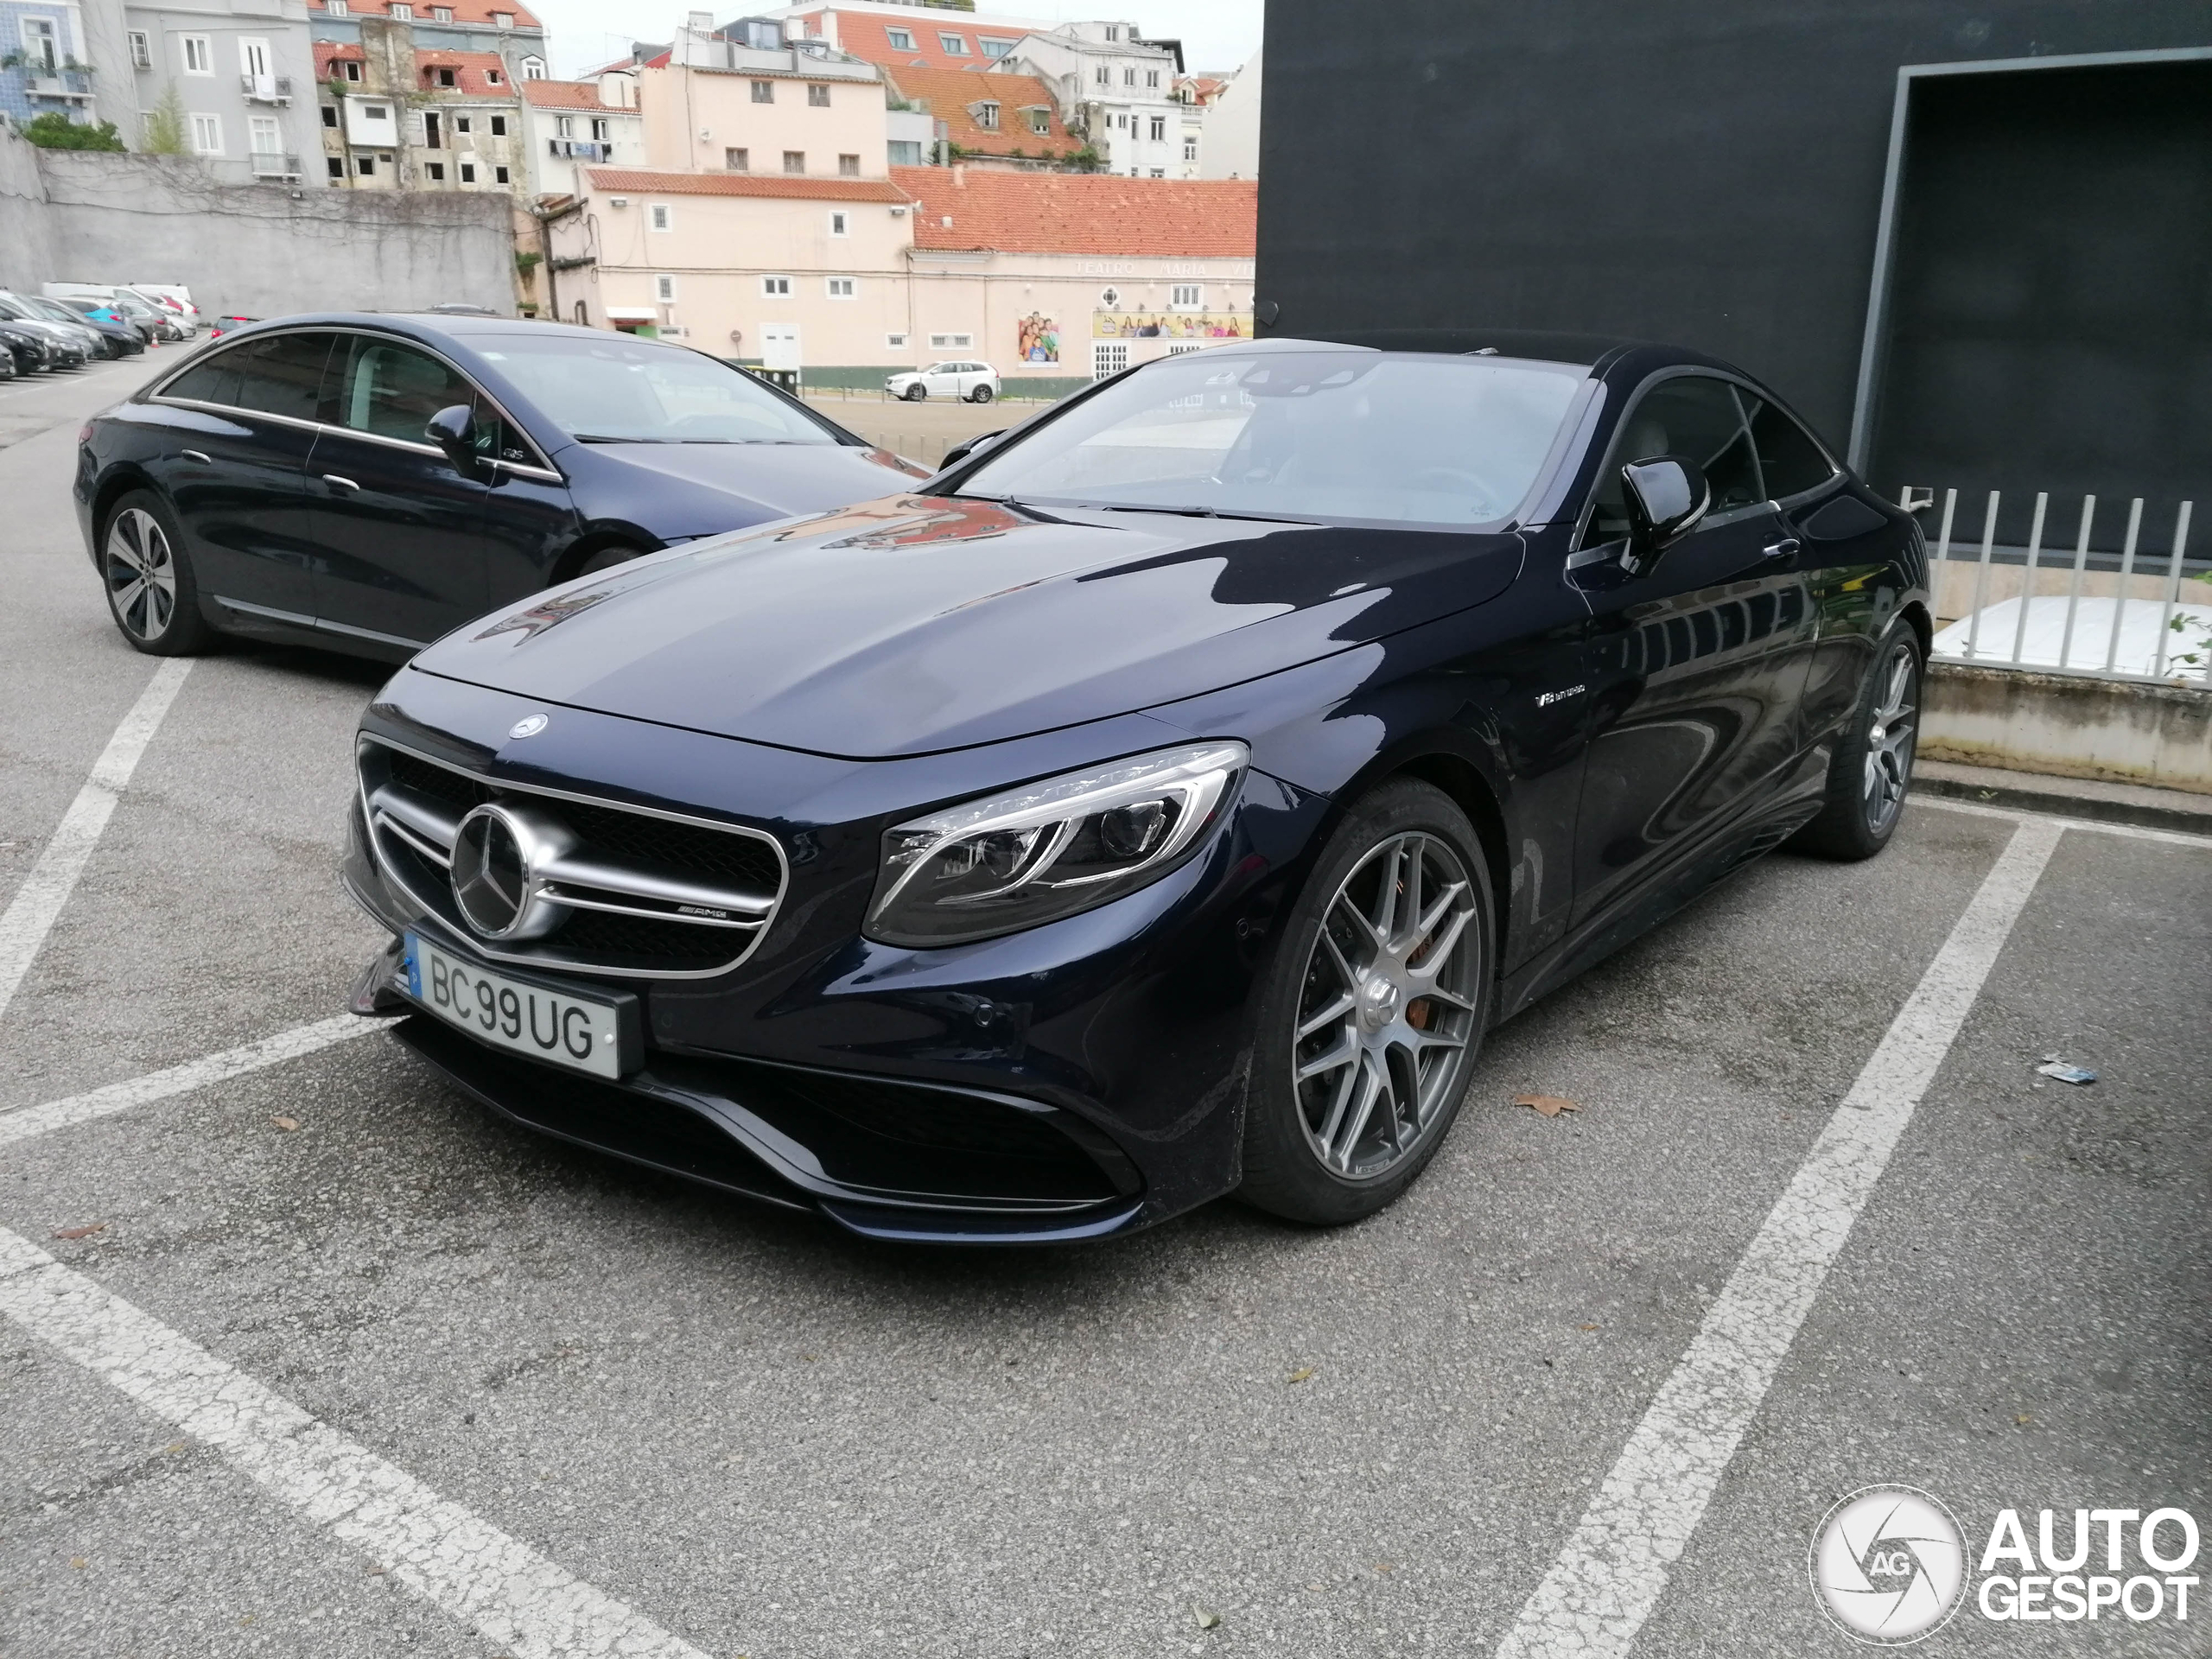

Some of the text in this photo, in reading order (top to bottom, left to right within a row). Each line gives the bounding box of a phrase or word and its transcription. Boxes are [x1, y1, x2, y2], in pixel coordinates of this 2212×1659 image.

[1076, 262, 1135, 275] TEATRO
[1535, 691, 1554, 708] V8
[692, 907, 727, 918] AMG
